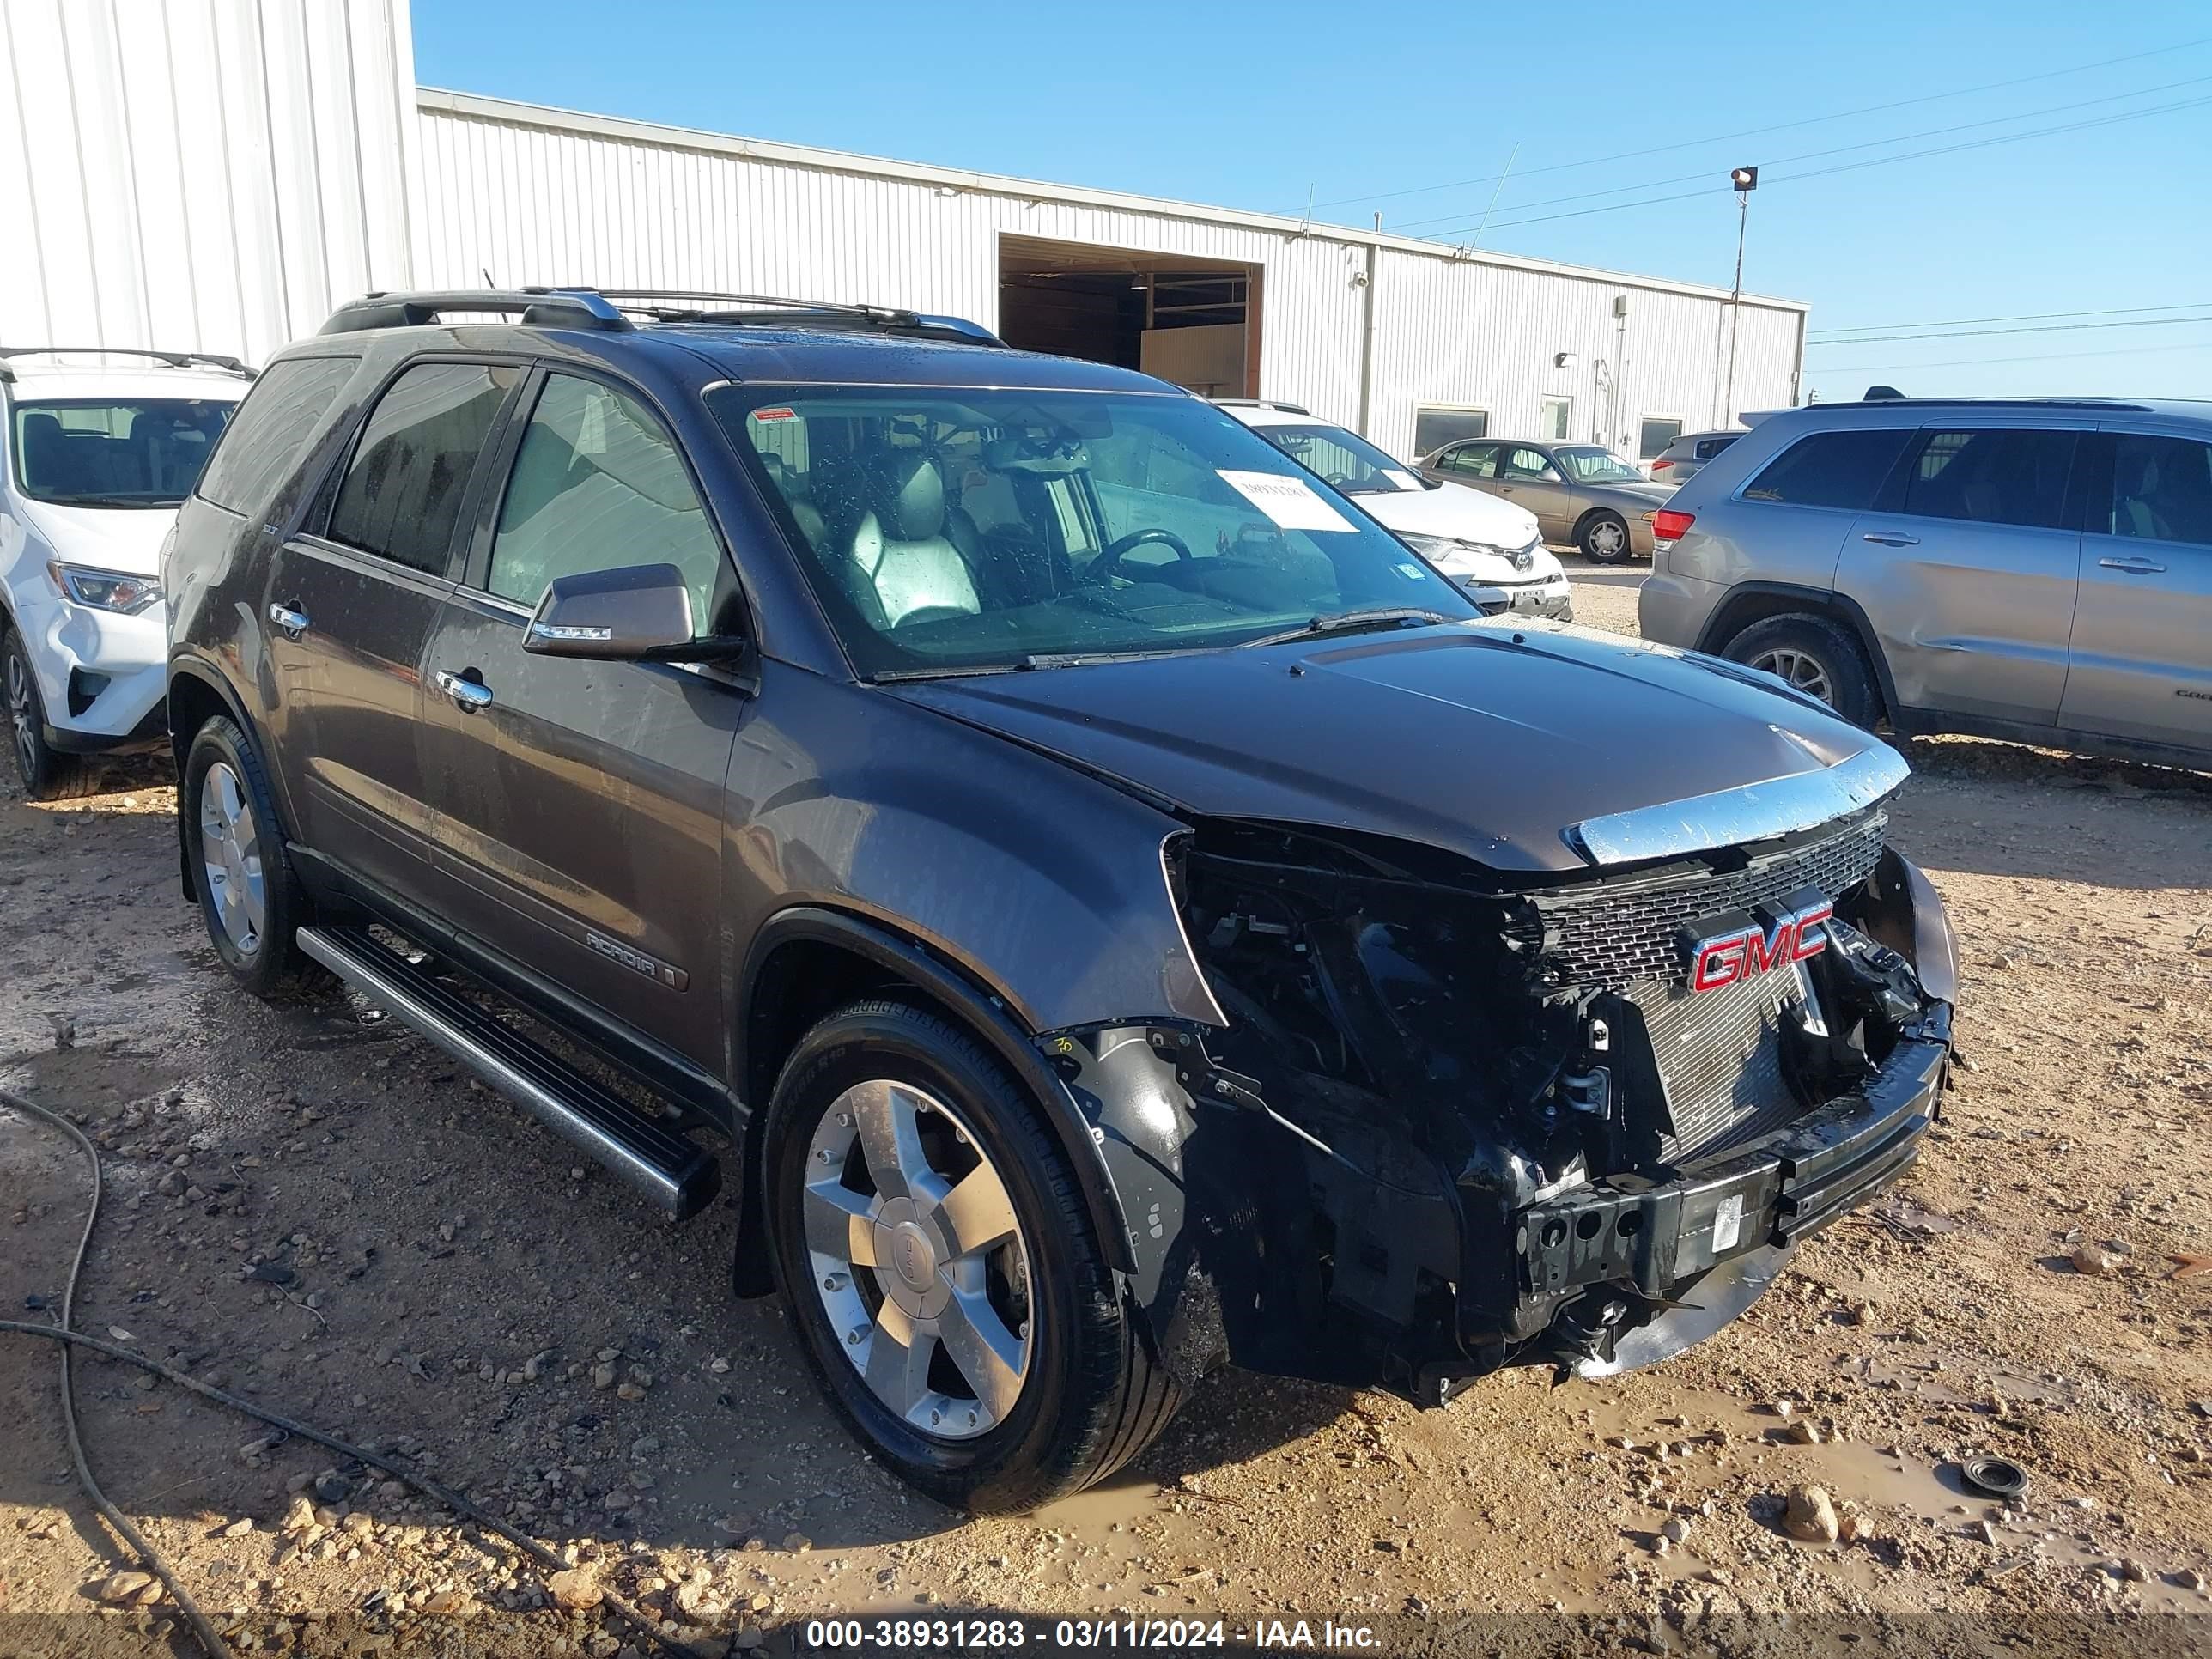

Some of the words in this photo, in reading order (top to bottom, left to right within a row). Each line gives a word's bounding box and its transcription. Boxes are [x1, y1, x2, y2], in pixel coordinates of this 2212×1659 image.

[586, 933, 656, 976] ACADIA
[1694, 902, 1833, 994] GMC
[906, 1237, 915, 1279] GMC
